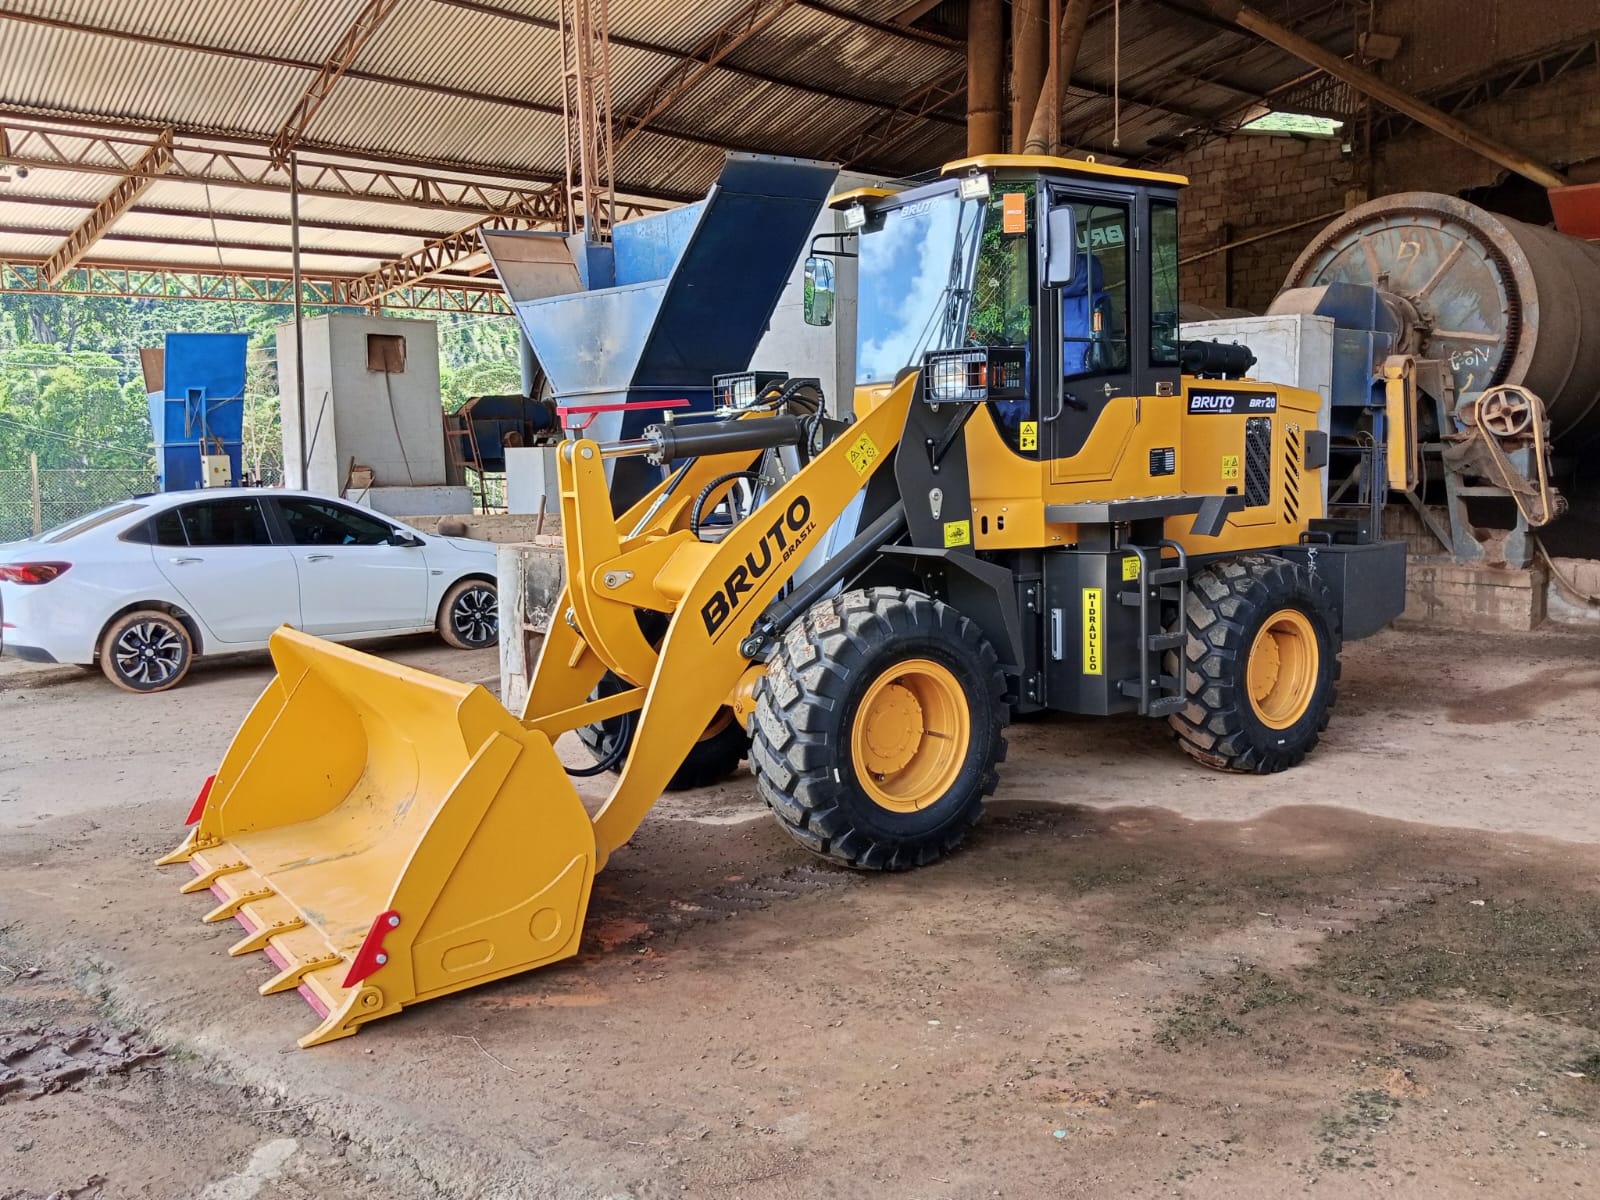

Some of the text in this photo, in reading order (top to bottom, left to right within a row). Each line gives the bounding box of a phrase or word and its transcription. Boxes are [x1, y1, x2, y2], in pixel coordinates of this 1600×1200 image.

[1191, 396, 1235, 408] BRUTO
[701, 495, 811, 637] BRUTO
[782, 522, 816, 563] BRASIL
[1088, 592, 1097, 671] HIDRÁULICO
